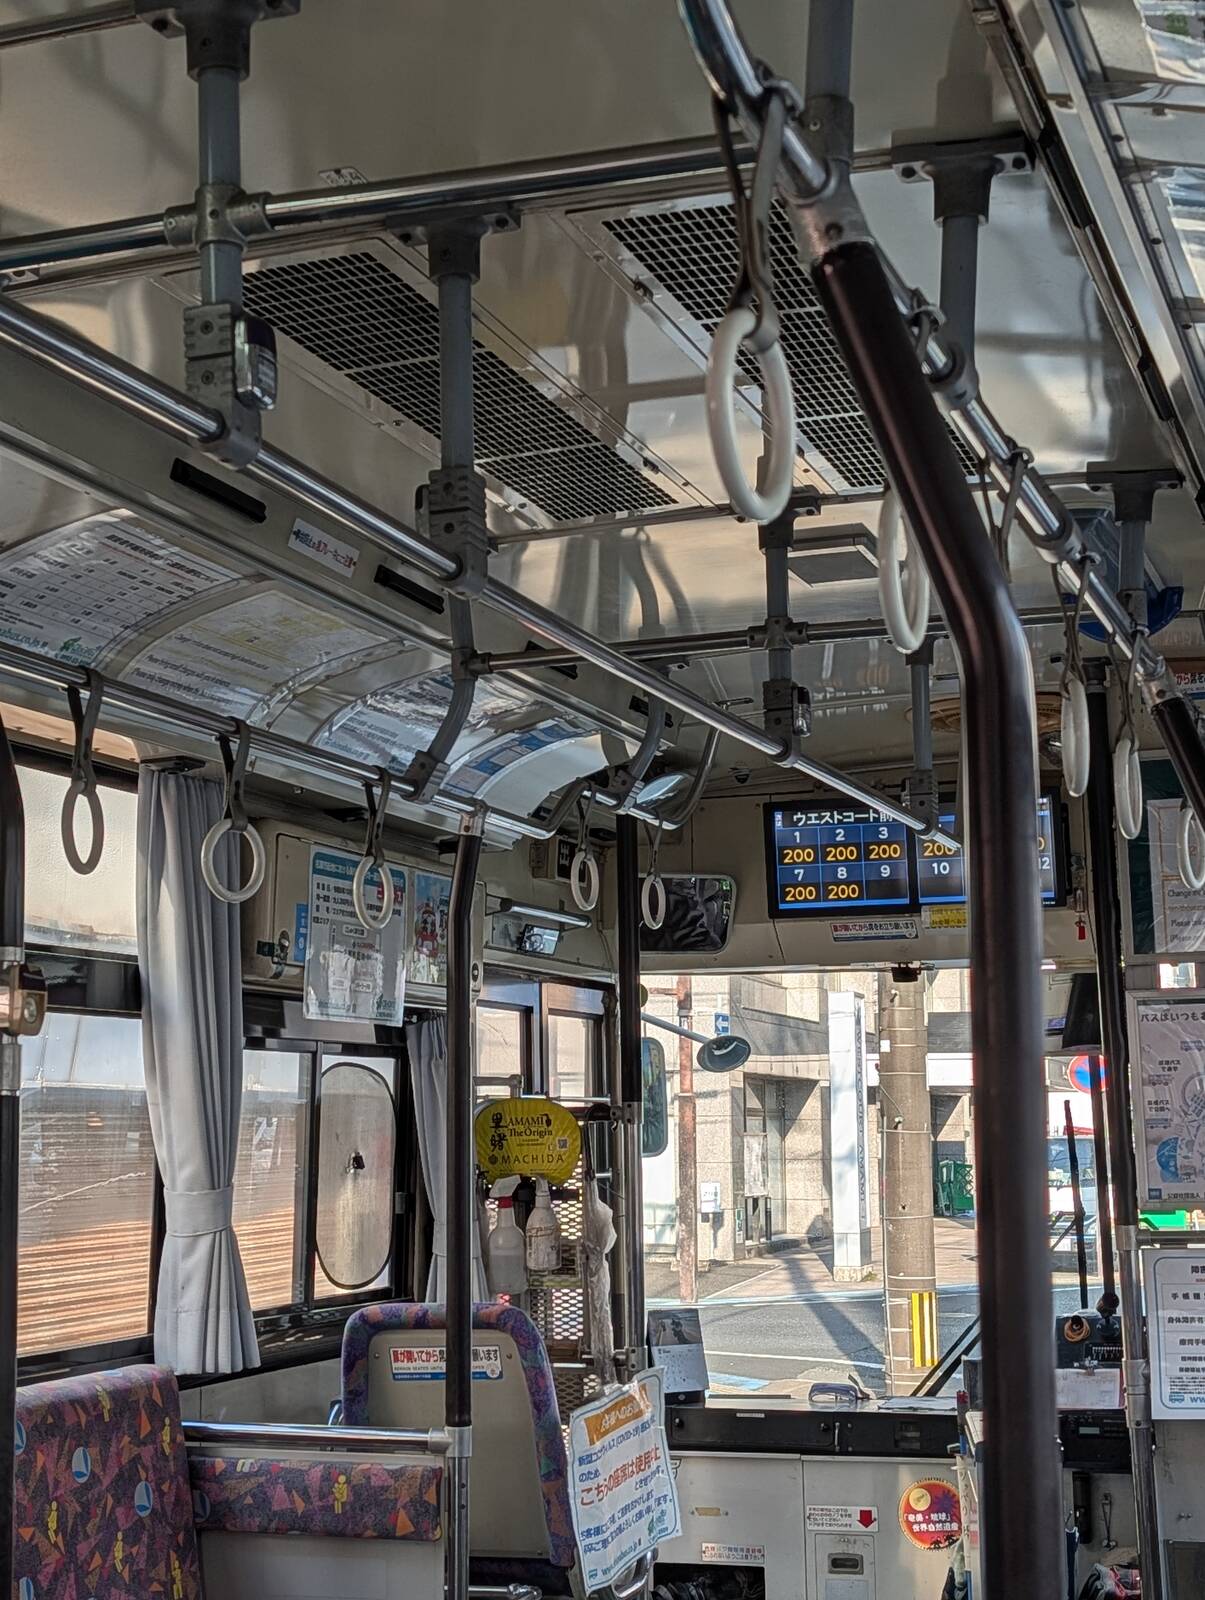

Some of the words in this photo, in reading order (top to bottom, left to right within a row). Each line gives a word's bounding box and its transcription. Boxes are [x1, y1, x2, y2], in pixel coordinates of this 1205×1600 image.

[793, 831, 801, 844] 1
[835, 829, 846, 842] 2
[878, 827, 889, 840] 3
[783, 849, 814, 864] 200
[826, 847, 857, 861] 200
[869, 844, 901, 859] 200
[796, 870, 804, 882] 7
[837, 867, 847, 880] 8
[880, 865, 891, 878] 9
[932, 862, 950, 876] 10
[785, 886, 817, 901] 200
[828, 884, 859, 899] 200
[508, 1115, 544, 1127] AMAMI
[508, 1128, 523, 1137] The
[524, 1127, 553, 1138] Origin
[501, 1154, 565, 1165] MACHIDA
